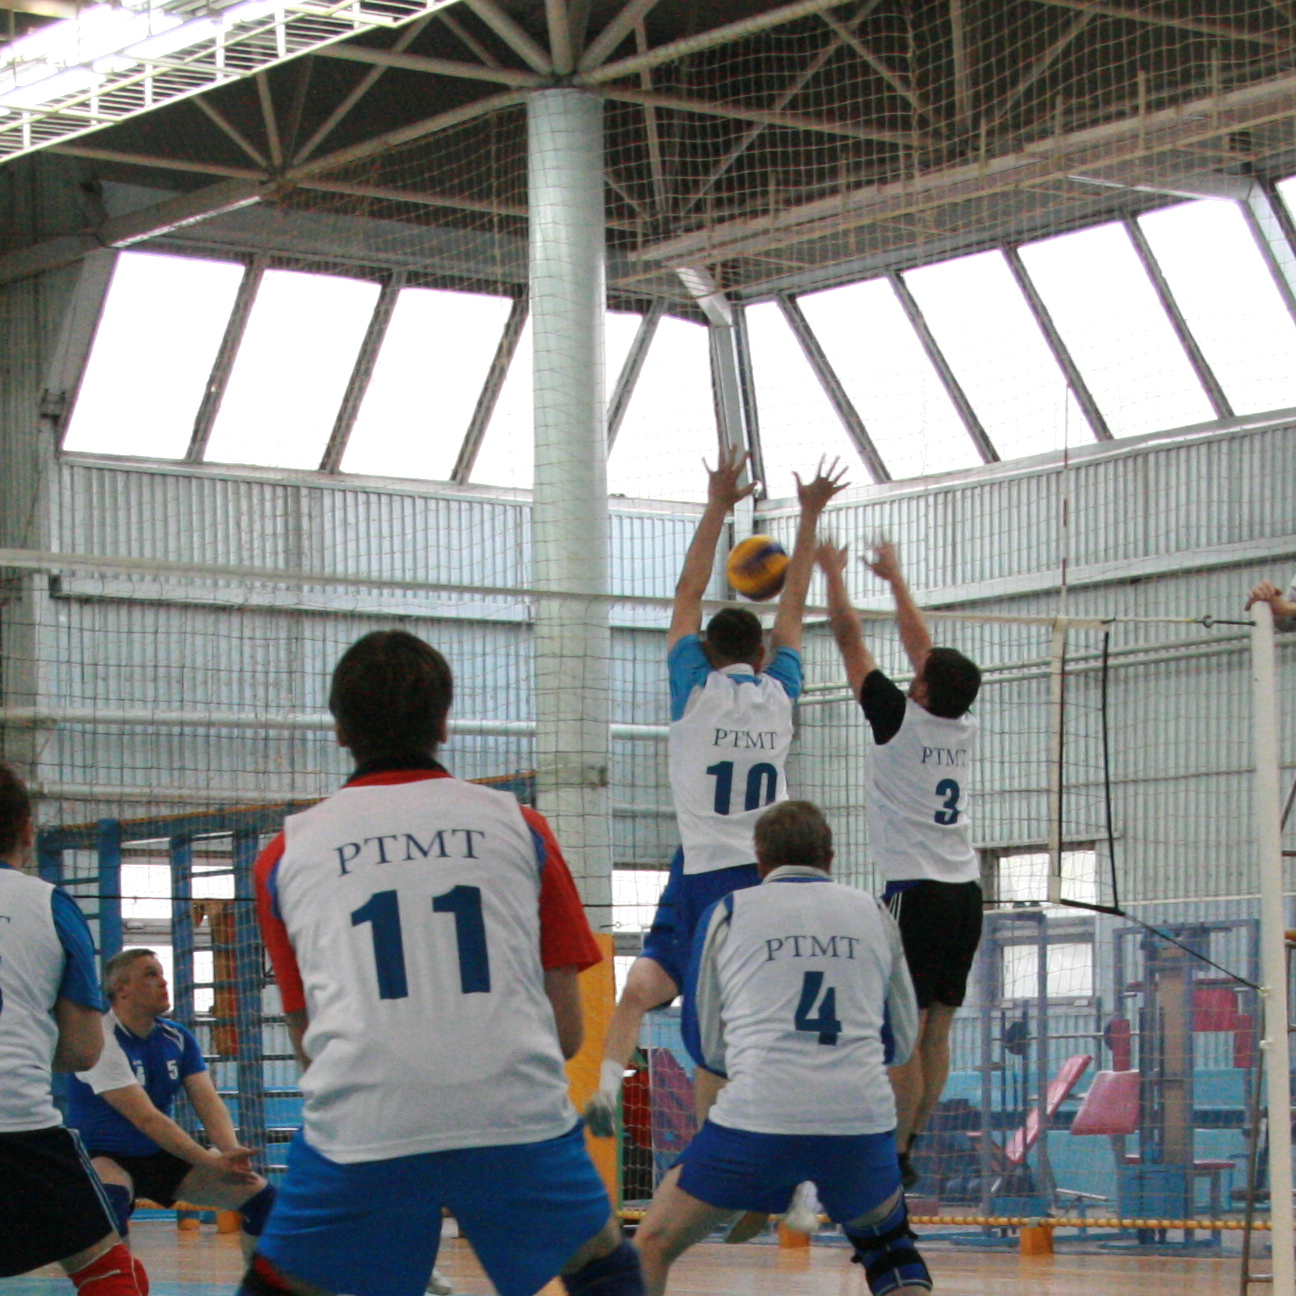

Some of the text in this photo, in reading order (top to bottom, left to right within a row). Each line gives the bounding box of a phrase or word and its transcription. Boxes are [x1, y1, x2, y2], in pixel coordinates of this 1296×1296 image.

[712, 728, 777, 750] PTMT
[706, 760, 778, 816] 10
[934, 778, 962, 825] 3
[333, 828, 486, 878] PTMT
[350, 884, 492, 1001] 11
[765, 935, 860, 962] PTMT
[794, 970, 843, 1046] 4
[166, 1059, 179, 1080] 5
